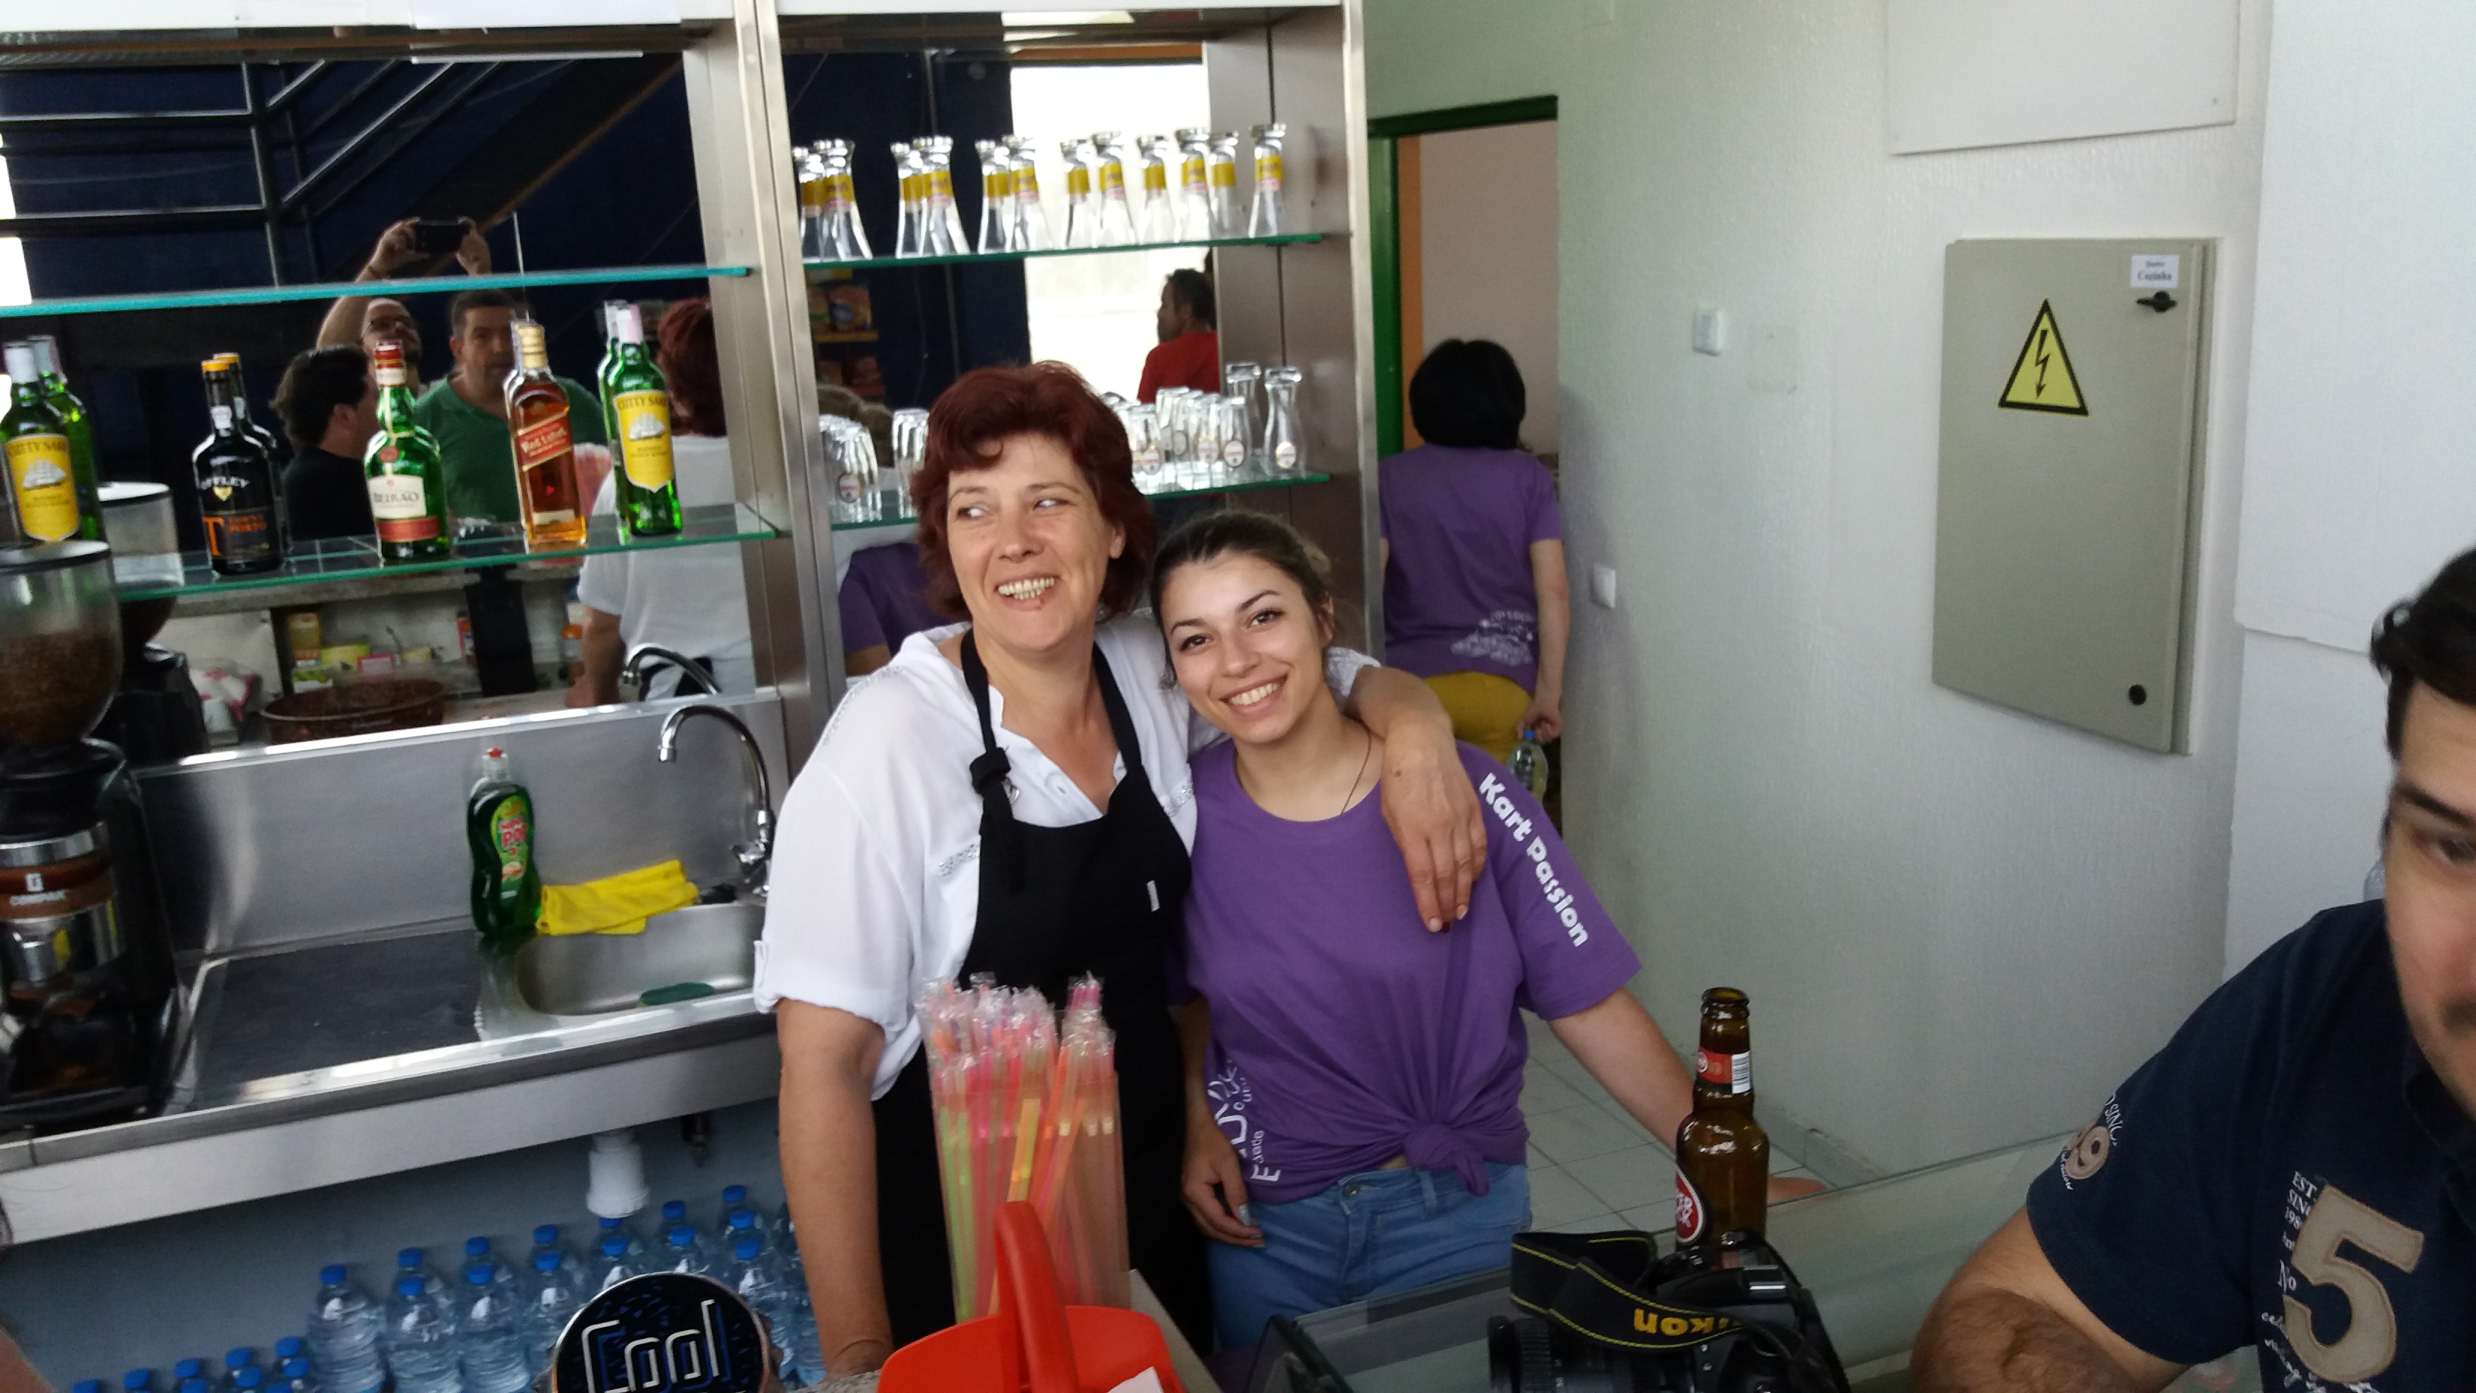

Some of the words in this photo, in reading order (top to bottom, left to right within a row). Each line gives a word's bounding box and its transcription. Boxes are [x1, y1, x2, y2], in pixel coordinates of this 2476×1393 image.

[1479, 772, 1533, 842] Kart
[1526, 835, 1588, 947] Passion
[1632, 1307, 1732, 1337] ikon
[2282, 1184, 2425, 1384] 5
